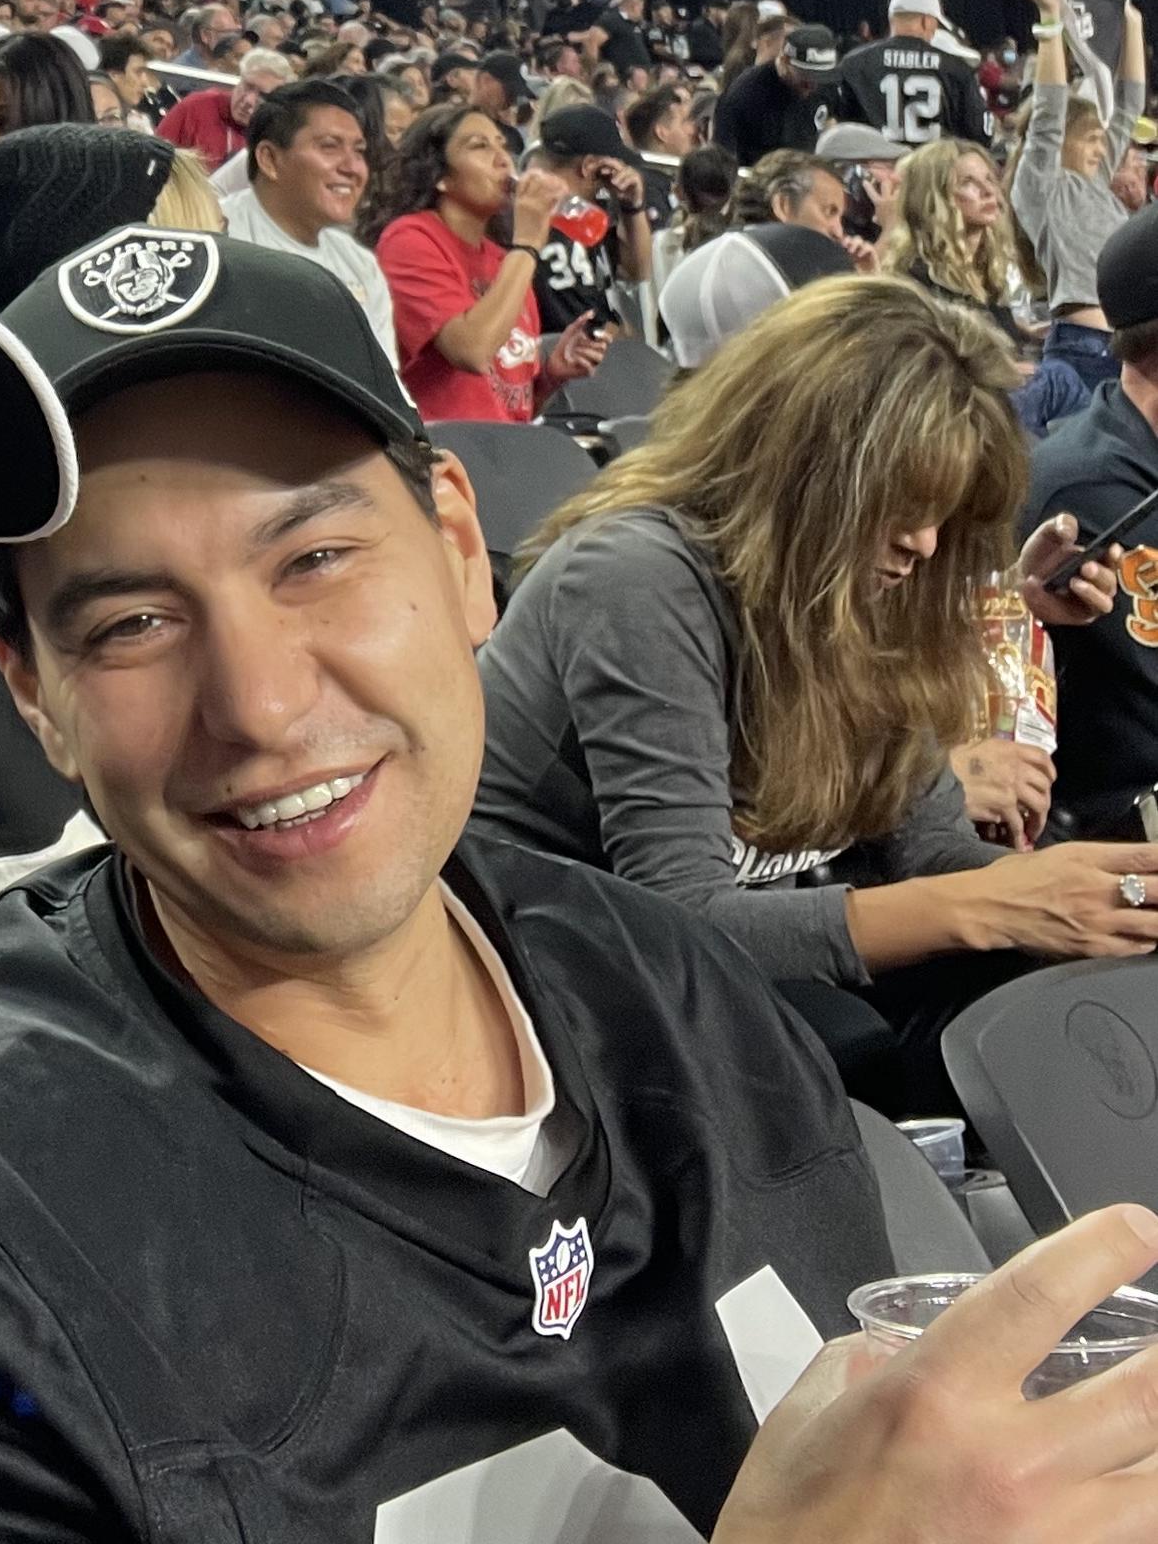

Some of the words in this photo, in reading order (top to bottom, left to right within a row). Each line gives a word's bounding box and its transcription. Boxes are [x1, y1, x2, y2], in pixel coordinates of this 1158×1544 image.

[883, 48, 940, 69] STABLER
[880, 73, 942, 143] 12
[539, 240, 597, 291] 34
[544, 1268, 582, 1322] NFL
